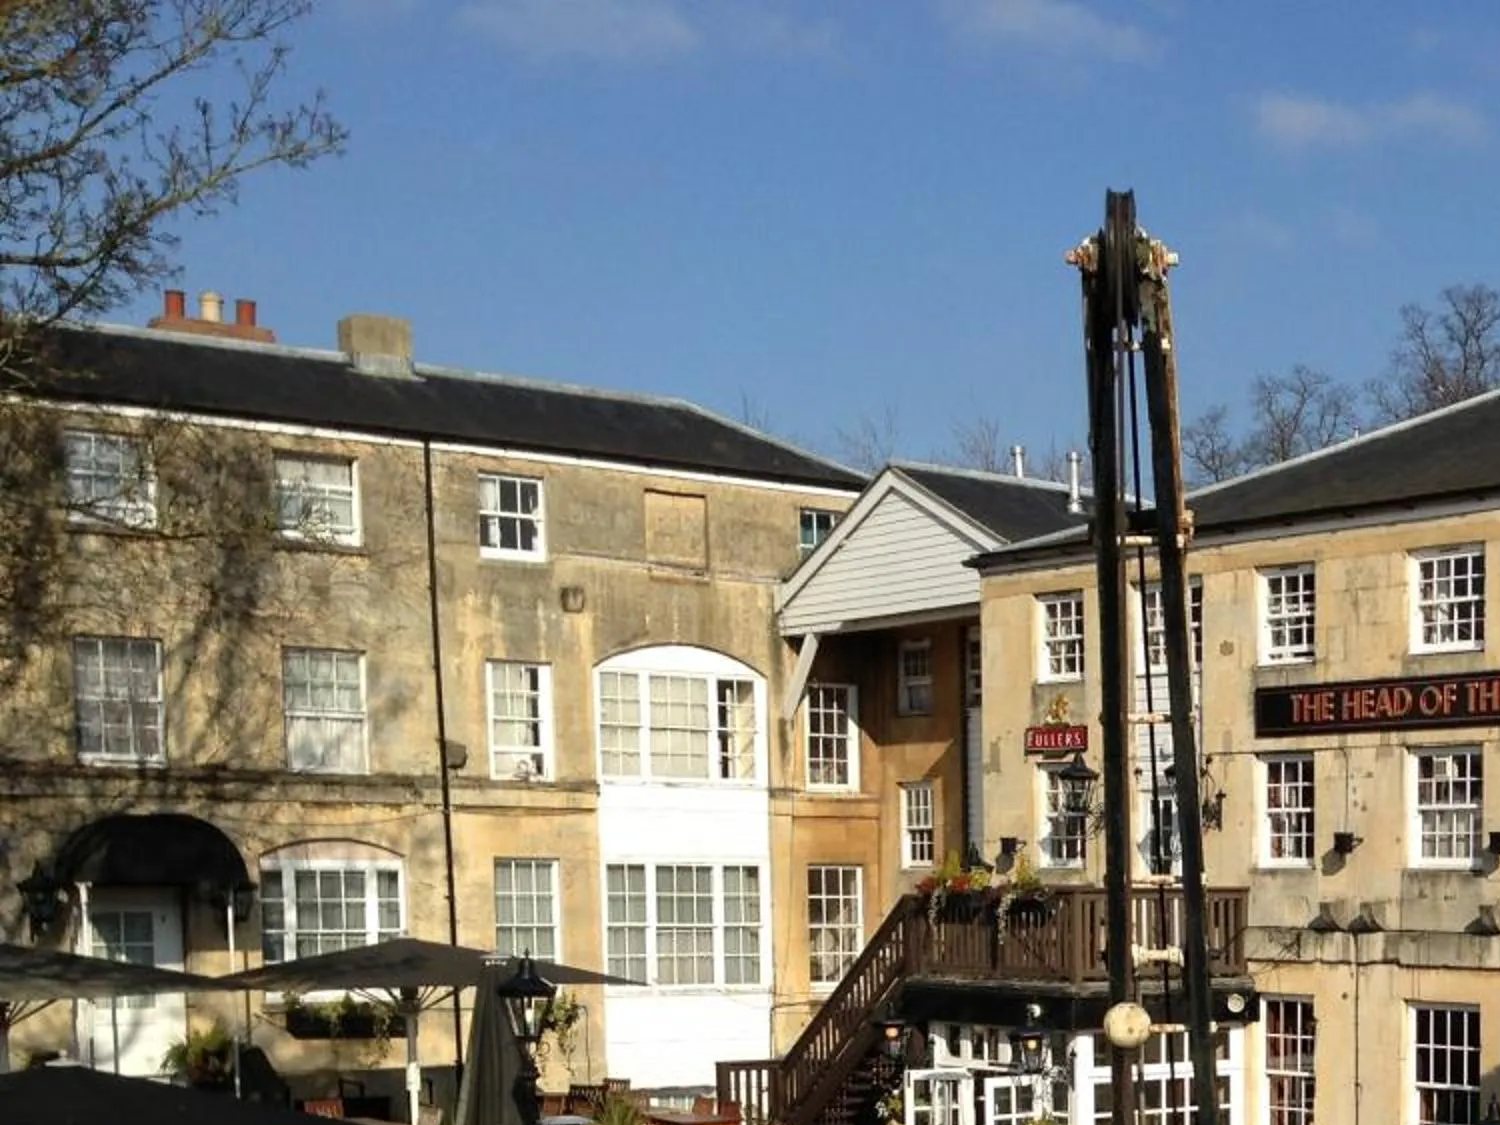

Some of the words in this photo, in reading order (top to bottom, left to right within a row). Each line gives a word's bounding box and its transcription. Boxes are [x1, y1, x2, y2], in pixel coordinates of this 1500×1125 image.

[1290, 691, 1335, 723] THE
[1341, 687, 1412, 721] HEAD
[1419, 683, 1457, 716] OF
